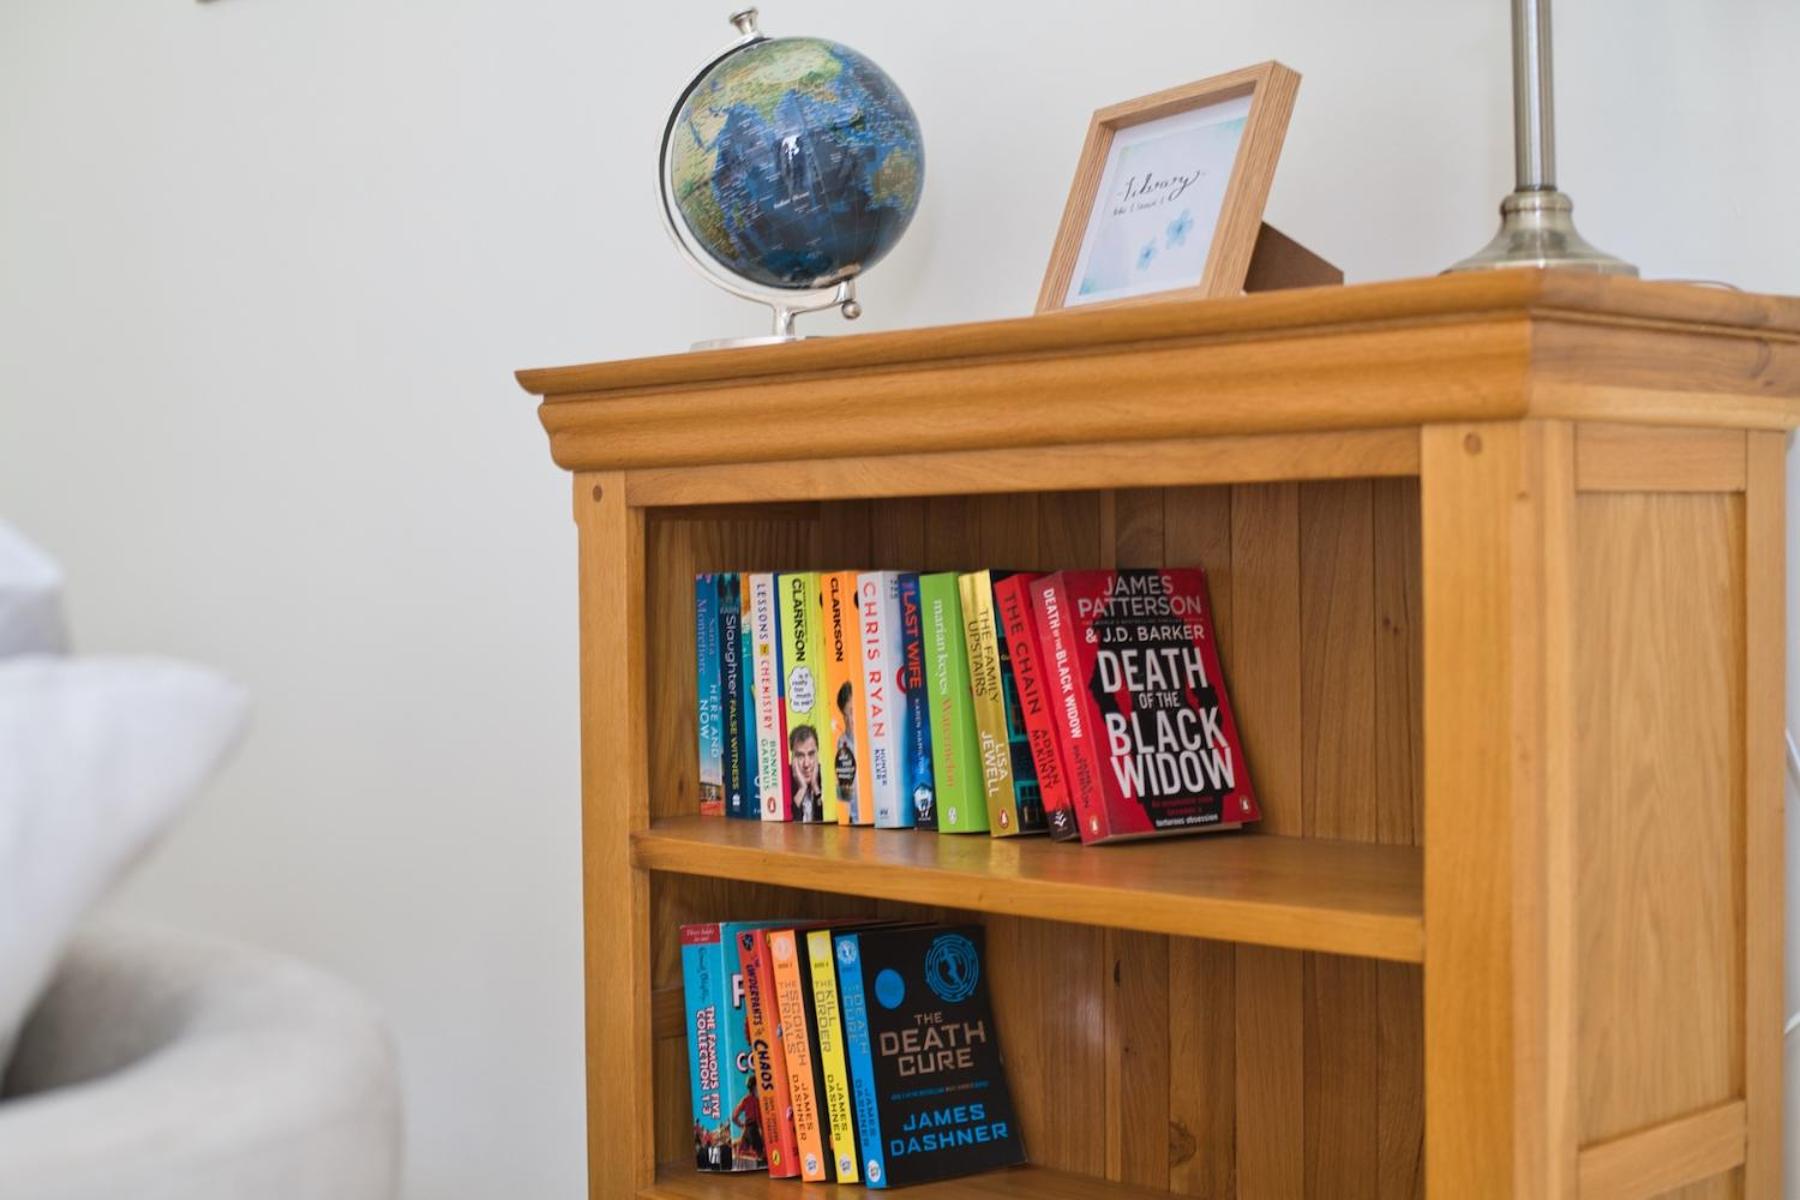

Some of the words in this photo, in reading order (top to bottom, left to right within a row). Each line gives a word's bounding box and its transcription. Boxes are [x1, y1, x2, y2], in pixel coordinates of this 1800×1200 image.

[1077, 596, 1203, 618] PATTERSON
[1103, 575, 1174, 596] JAMES
[757, 583, 769, 640] LESSONS
[791, 578, 806, 662] CLARKSON
[830, 577, 844, 663] CLARKSON
[863, 581, 881, 661] CHRIS
[902, 590, 918, 637] LAST
[979, 607, 991, 640] THE
[1085, 627, 1098, 643] &
[1103, 626, 1133, 643] J.D.
[1137, 623, 1205, 641] BARKER
[724, 614, 739, 698] Slaughter
[907, 643, 922, 689] WIFE
[967, 620, 987, 697] UPSTAIRS
[984, 646, 1000, 703] FAMILY
[1004, 592, 1024, 636] THE
[1015, 641, 1042, 716] CHAIN
[1043, 588, 1060, 629] DEATH
[1055, 649, 1072, 696] BLACK
[1064, 697, 1082, 740] WIDOW
[1097, 647, 1209, 693] DEATH
[699, 699, 710, 740] NOW
[709, 685, 719, 721] HERE
[729, 699, 738, 733] FALSE
[760, 660, 774, 730] CHEMISTRY
[869, 670, 885, 738] RYAN
[914, 698, 922, 728] KAREN
[1138, 692, 1153, 709] OF
[1155, 691, 1181, 709] THE
[711, 726, 721, 758] AND
[1104, 706, 1229, 756] BLACK
[731, 736, 741, 790] WITNESS
[760, 738, 770, 791] GARMUS
[769, 740, 778, 788] BONNIE
[879, 748, 888, 786] HUNTER
[980, 731, 1000, 798] JEWELL
[995, 742, 1009, 782] LISA
[1040, 729, 1061, 785] ADRIAN
[1110, 746, 1237, 799] WIDOW
[704, 1005, 716, 1030] THE
[780, 990, 796, 1055] TRIALS
[791, 989, 808, 1067] SCORCH
[815, 990, 832, 1053] ORDER
[827, 989, 837, 1028] KILL
[913, 1011, 944, 1026] THE
[696, 1010, 711, 1091] COLLECTION
[706, 1033, 720, 1089] FAMOUS
[879, 1020, 988, 1057] DEATH
[897, 1047, 976, 1078] CURE
[753, 1038, 774, 1091] CHAOS
[711, 1091, 721, 1120] FIVE
[792, 1074, 807, 1142] DASHNER
[801, 1083, 814, 1132] JAMES
[827, 1074, 842, 1142] DASHNER
[836, 1082, 849, 1132] JAMES
[854, 1078, 871, 1148] DASHNER
[863, 1087, 877, 1138] JAMES
[903, 1103, 986, 1132] JAMES
[890, 1123, 1009, 1158] DASHNER
